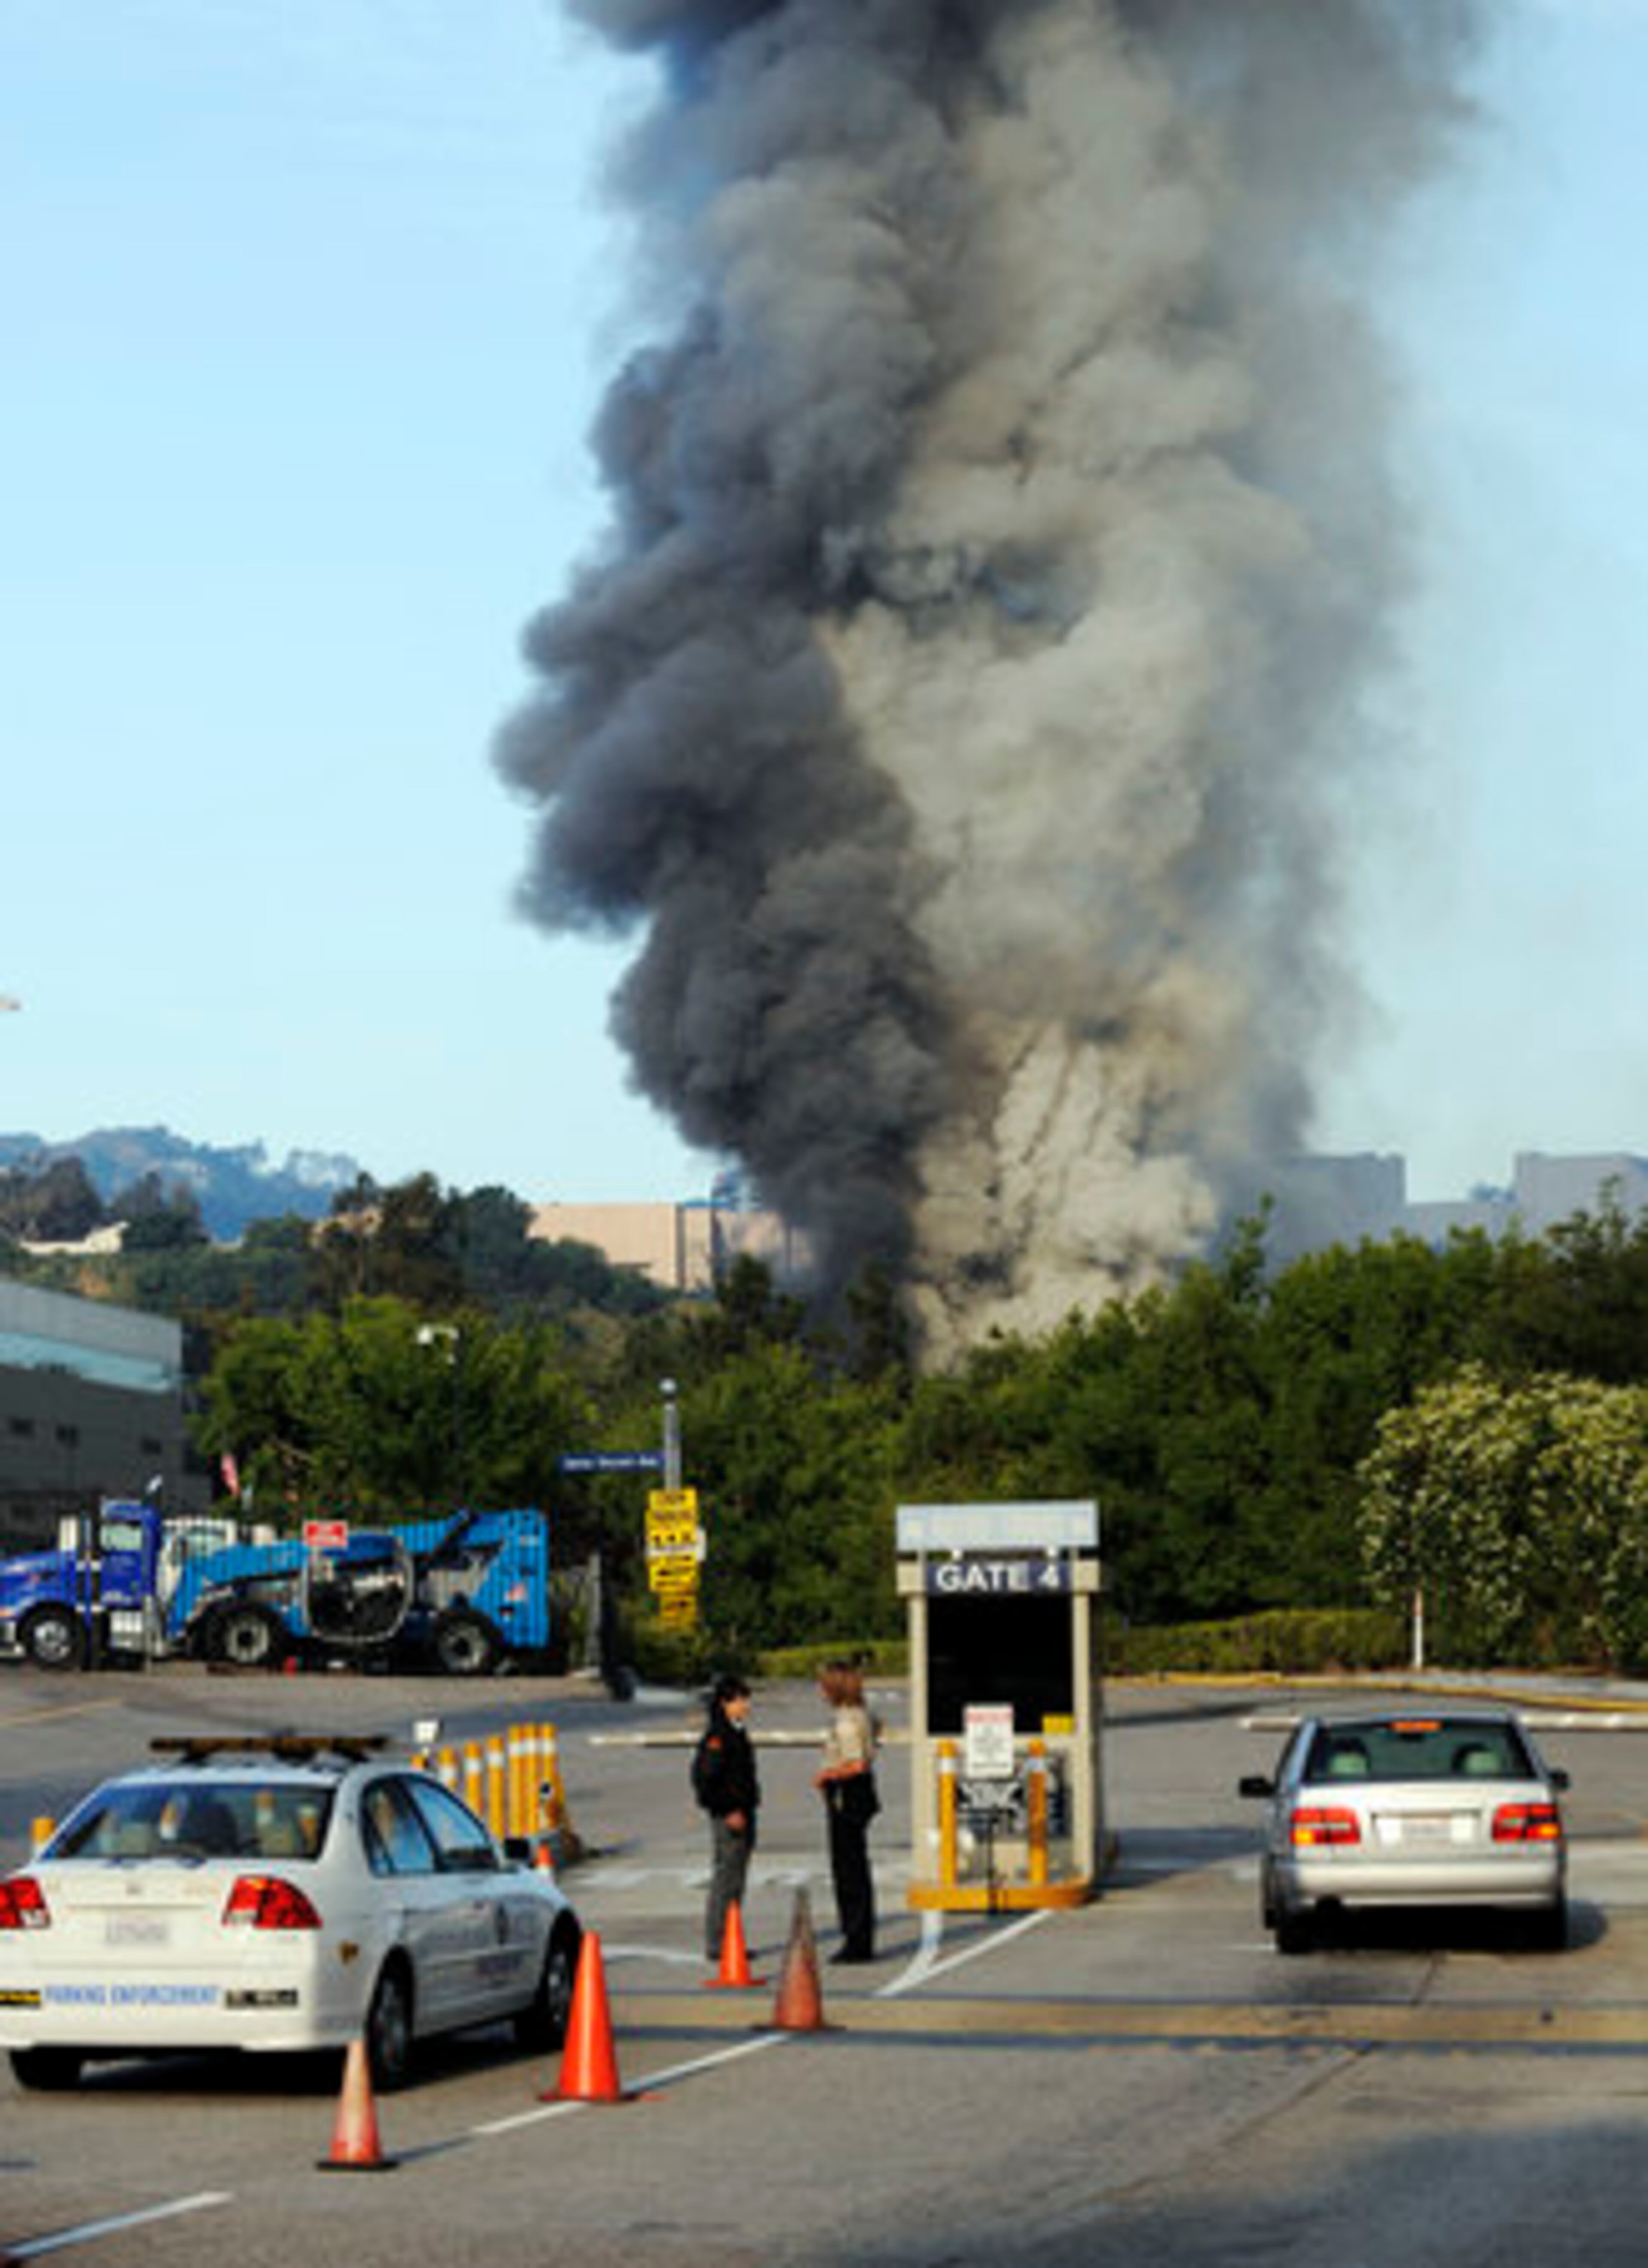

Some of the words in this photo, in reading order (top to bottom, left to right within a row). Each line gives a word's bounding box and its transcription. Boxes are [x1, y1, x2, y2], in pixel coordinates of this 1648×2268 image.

[936, 1562, 1030, 1591] GATE
[1039, 1563, 1059, 1588] 4
[44, 1985, 106, 2005] PARKING
[111, 1985, 219, 2005] ENFORCEMENT
